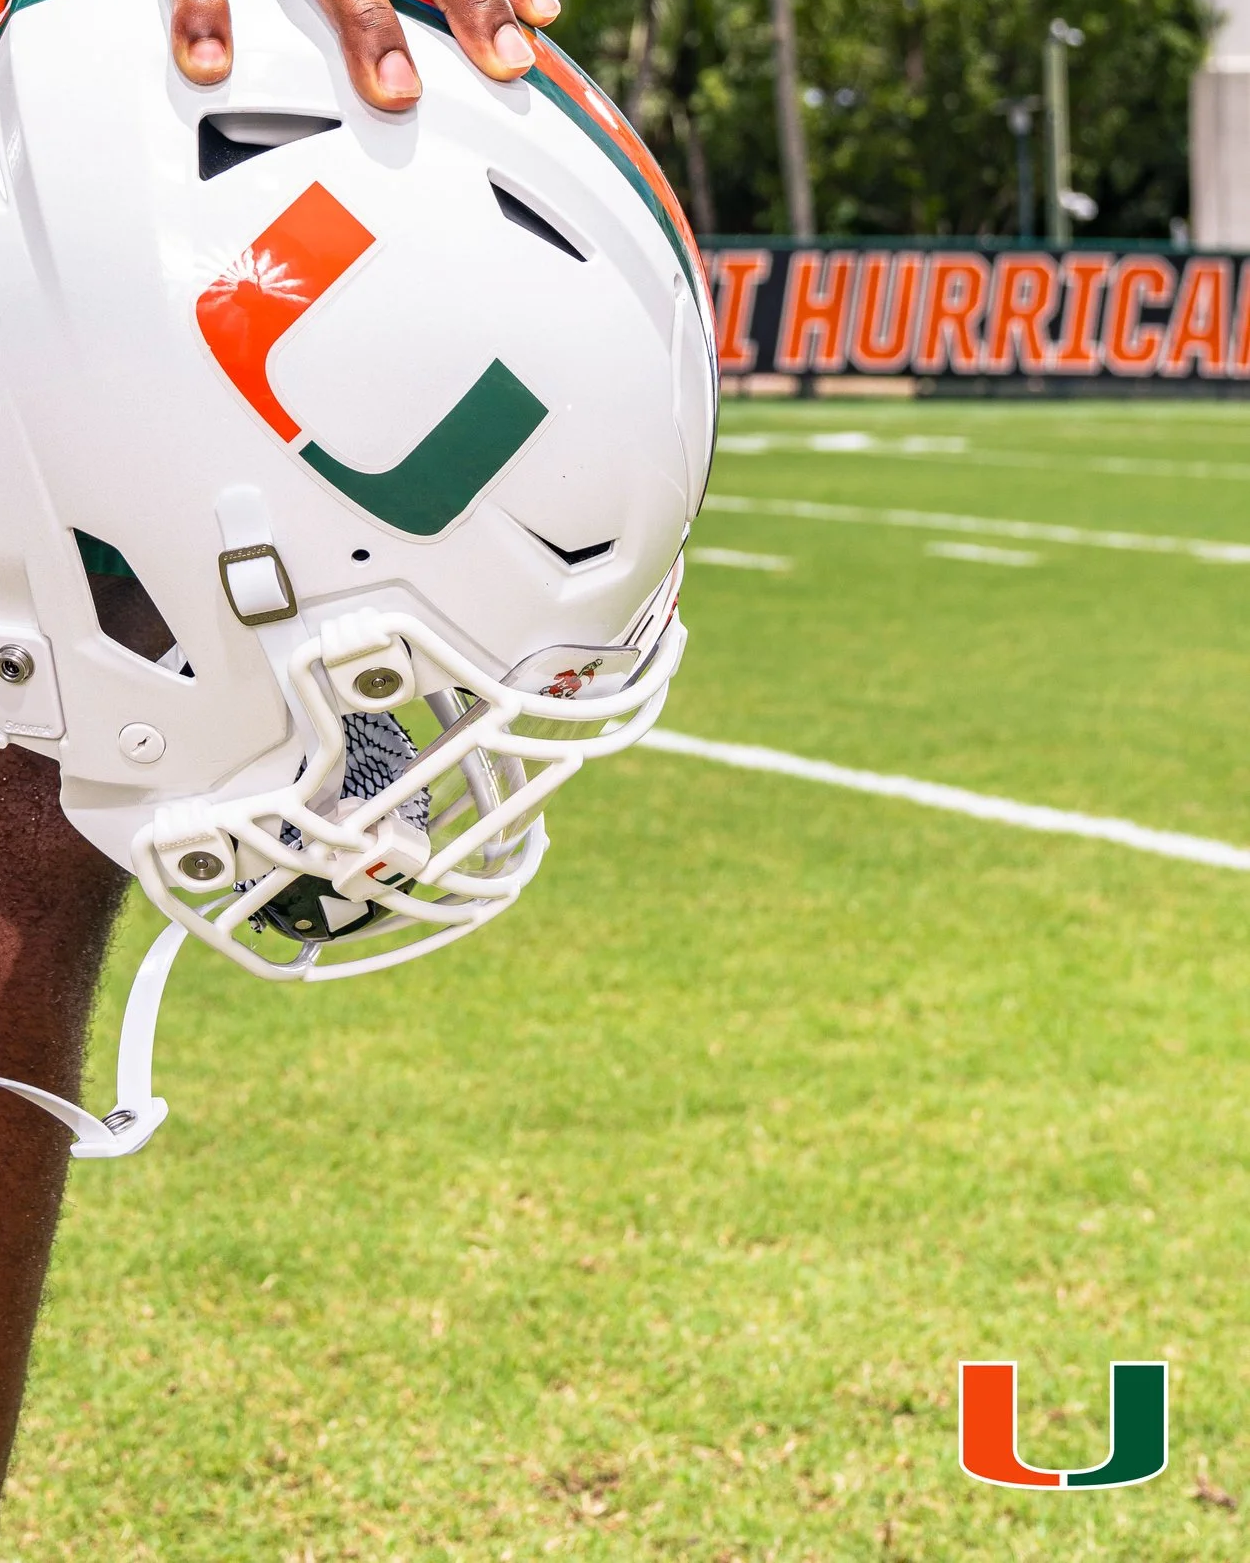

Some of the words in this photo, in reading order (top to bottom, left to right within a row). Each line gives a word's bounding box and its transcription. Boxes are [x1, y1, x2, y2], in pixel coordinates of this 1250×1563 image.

[196, 180, 549, 536] U
[702, 249, 773, 373] I
[774, 249, 1250, 376] HURRICA
[365, 861, 406, 886] U
